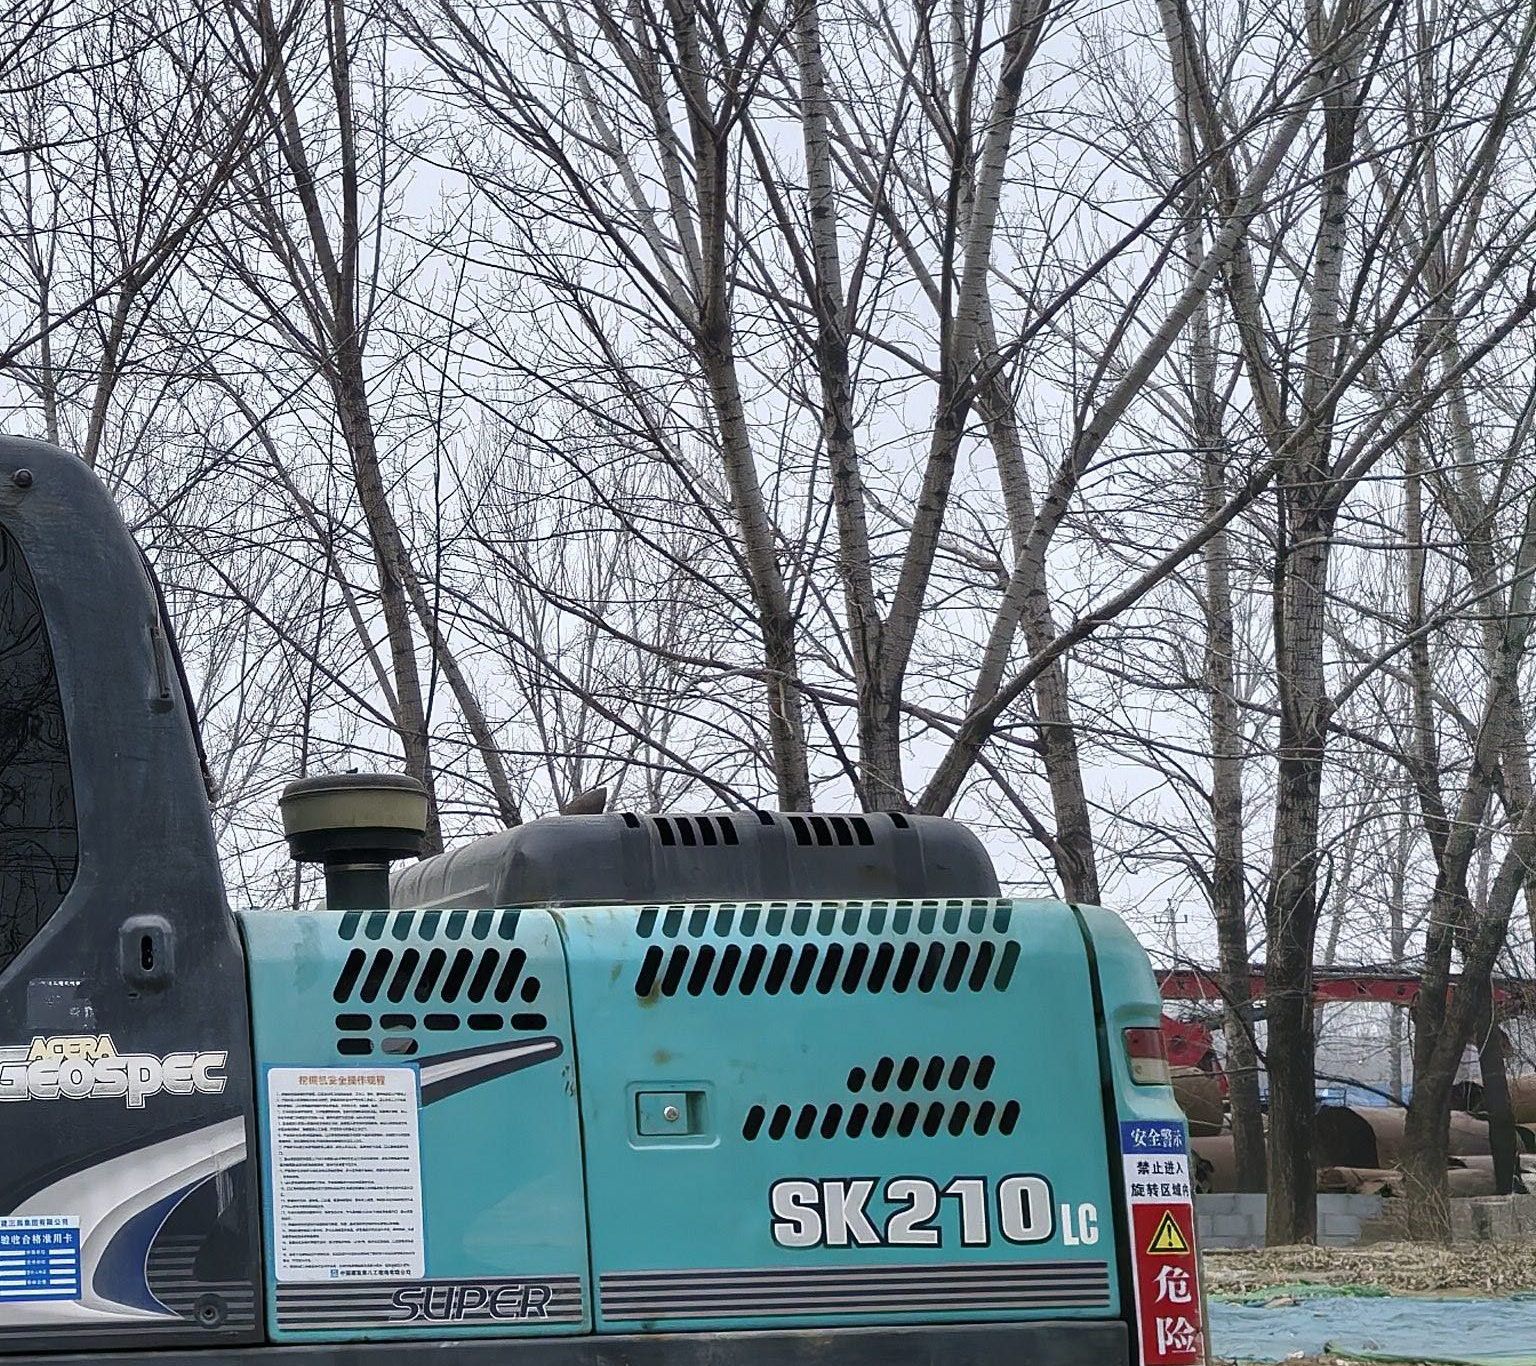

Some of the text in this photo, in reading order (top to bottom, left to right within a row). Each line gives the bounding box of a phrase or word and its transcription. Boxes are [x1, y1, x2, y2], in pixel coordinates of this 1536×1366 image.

[27, 1035, 117, 1062] ACERA
[1130, 1128, 1183, 1148] 安全警示
[1137, 1160, 1184, 1176] 禁止进入
[1131, 1182, 1190, 1198] 旋转区域内
[388, 1284, 553, 1323] SUPER
[1152, 1264, 1198, 1355] 危险
